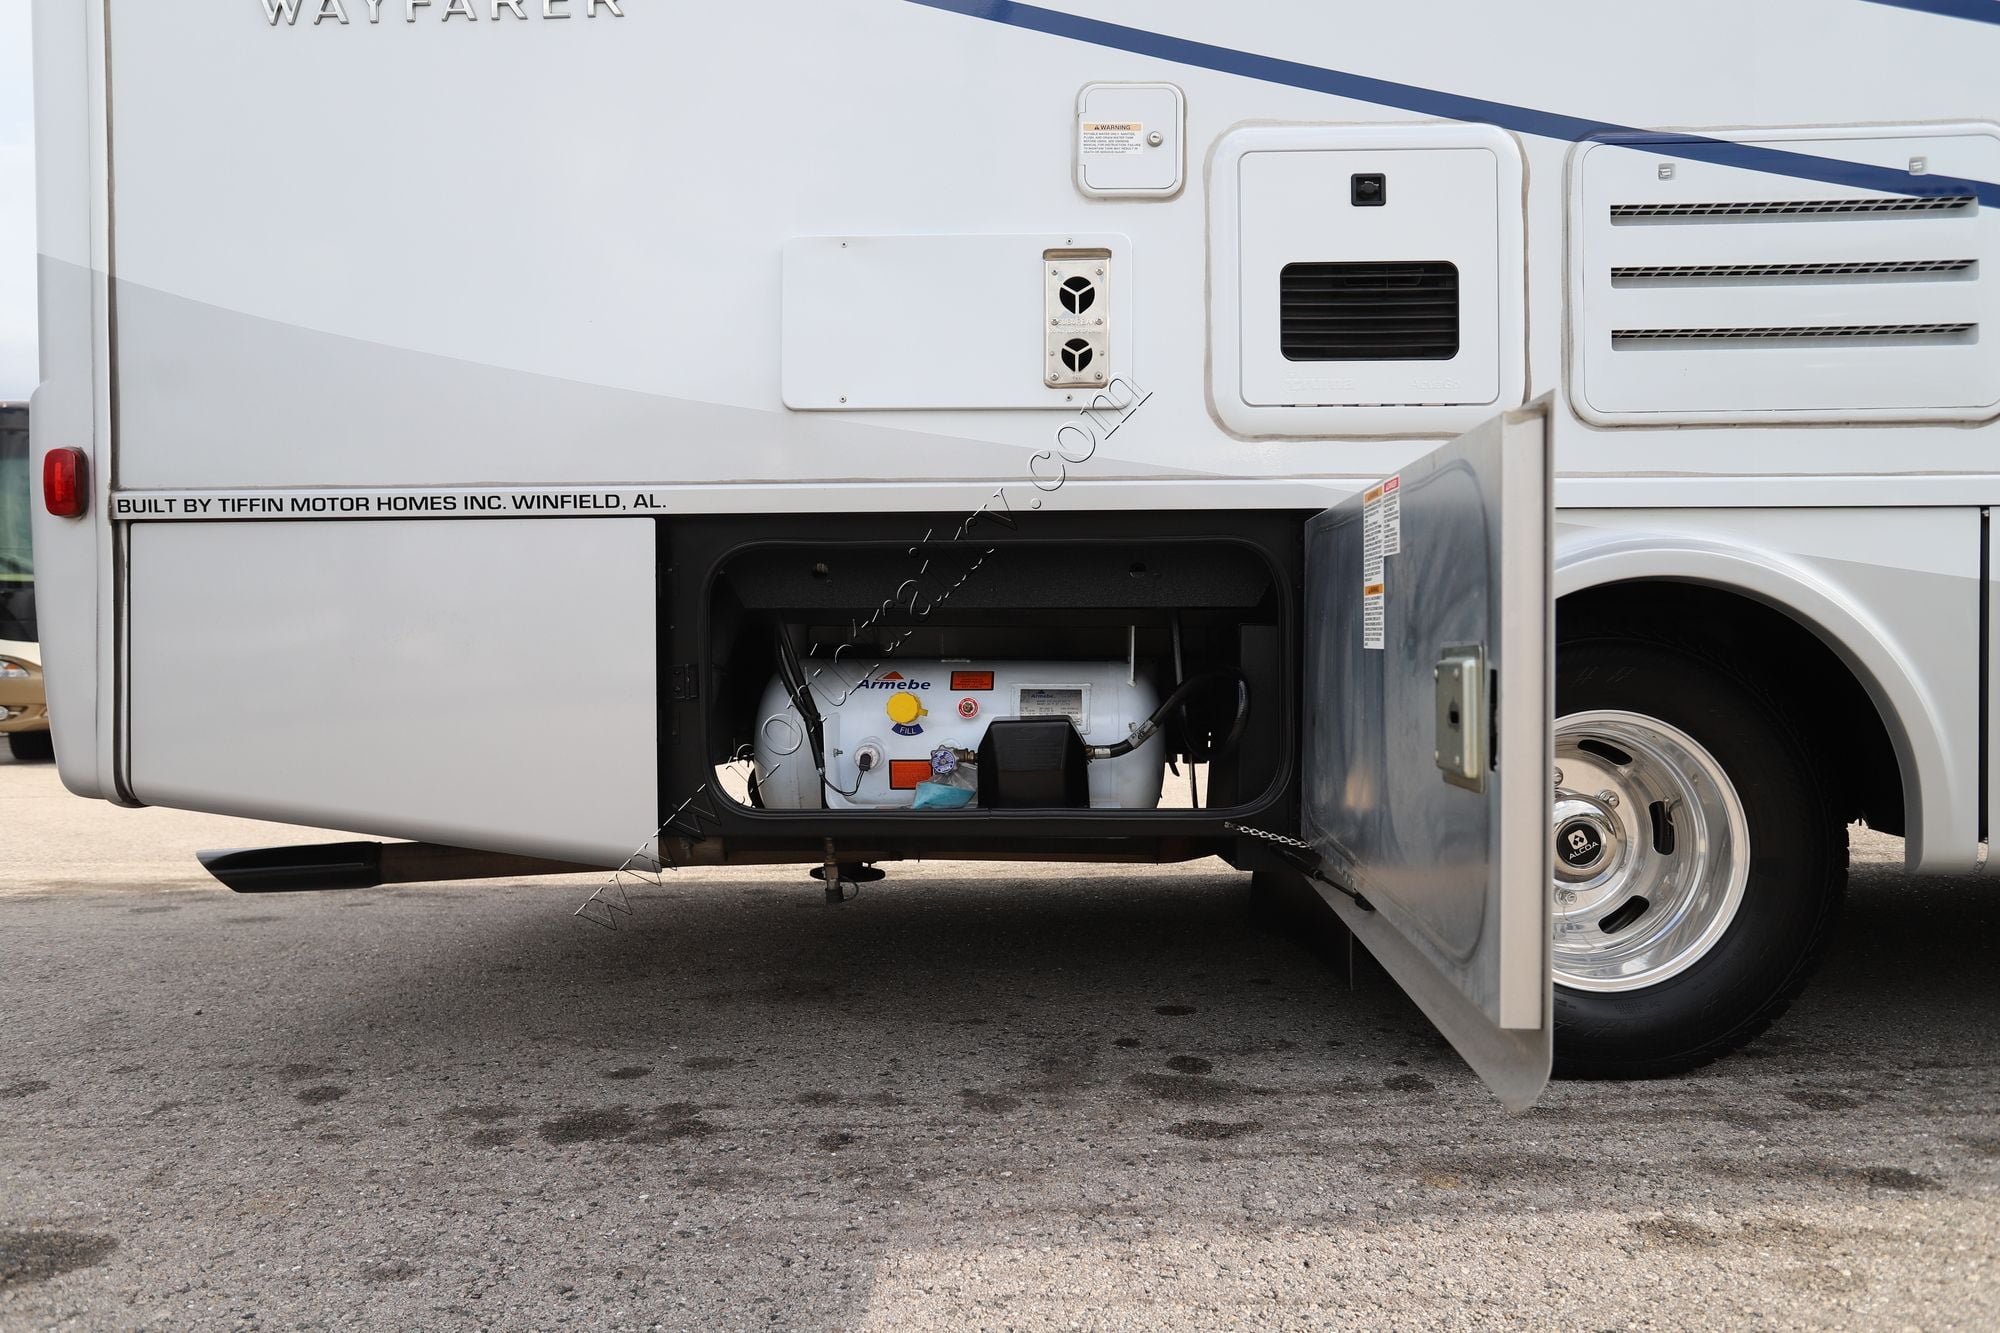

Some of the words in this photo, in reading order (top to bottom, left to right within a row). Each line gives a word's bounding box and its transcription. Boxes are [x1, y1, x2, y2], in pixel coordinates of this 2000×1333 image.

[261, 0, 624, 26] WAYFARER
[117, 499, 177, 513] BUILT
[183, 498, 212, 513] BY
[218, 498, 283, 513] TIFFIN
[290, 497, 369, 512] MOTOR
[377, 496, 457, 511] HOMES
[464, 495, 507, 510] INC.
[511, 494, 626, 511] WINFIELD,
[633, 494, 667, 509] AL.
[857, 679, 931, 690] Armebe
[900, 726, 917, 735] FILL
[1569, 841, 1599, 860] ALCOA
